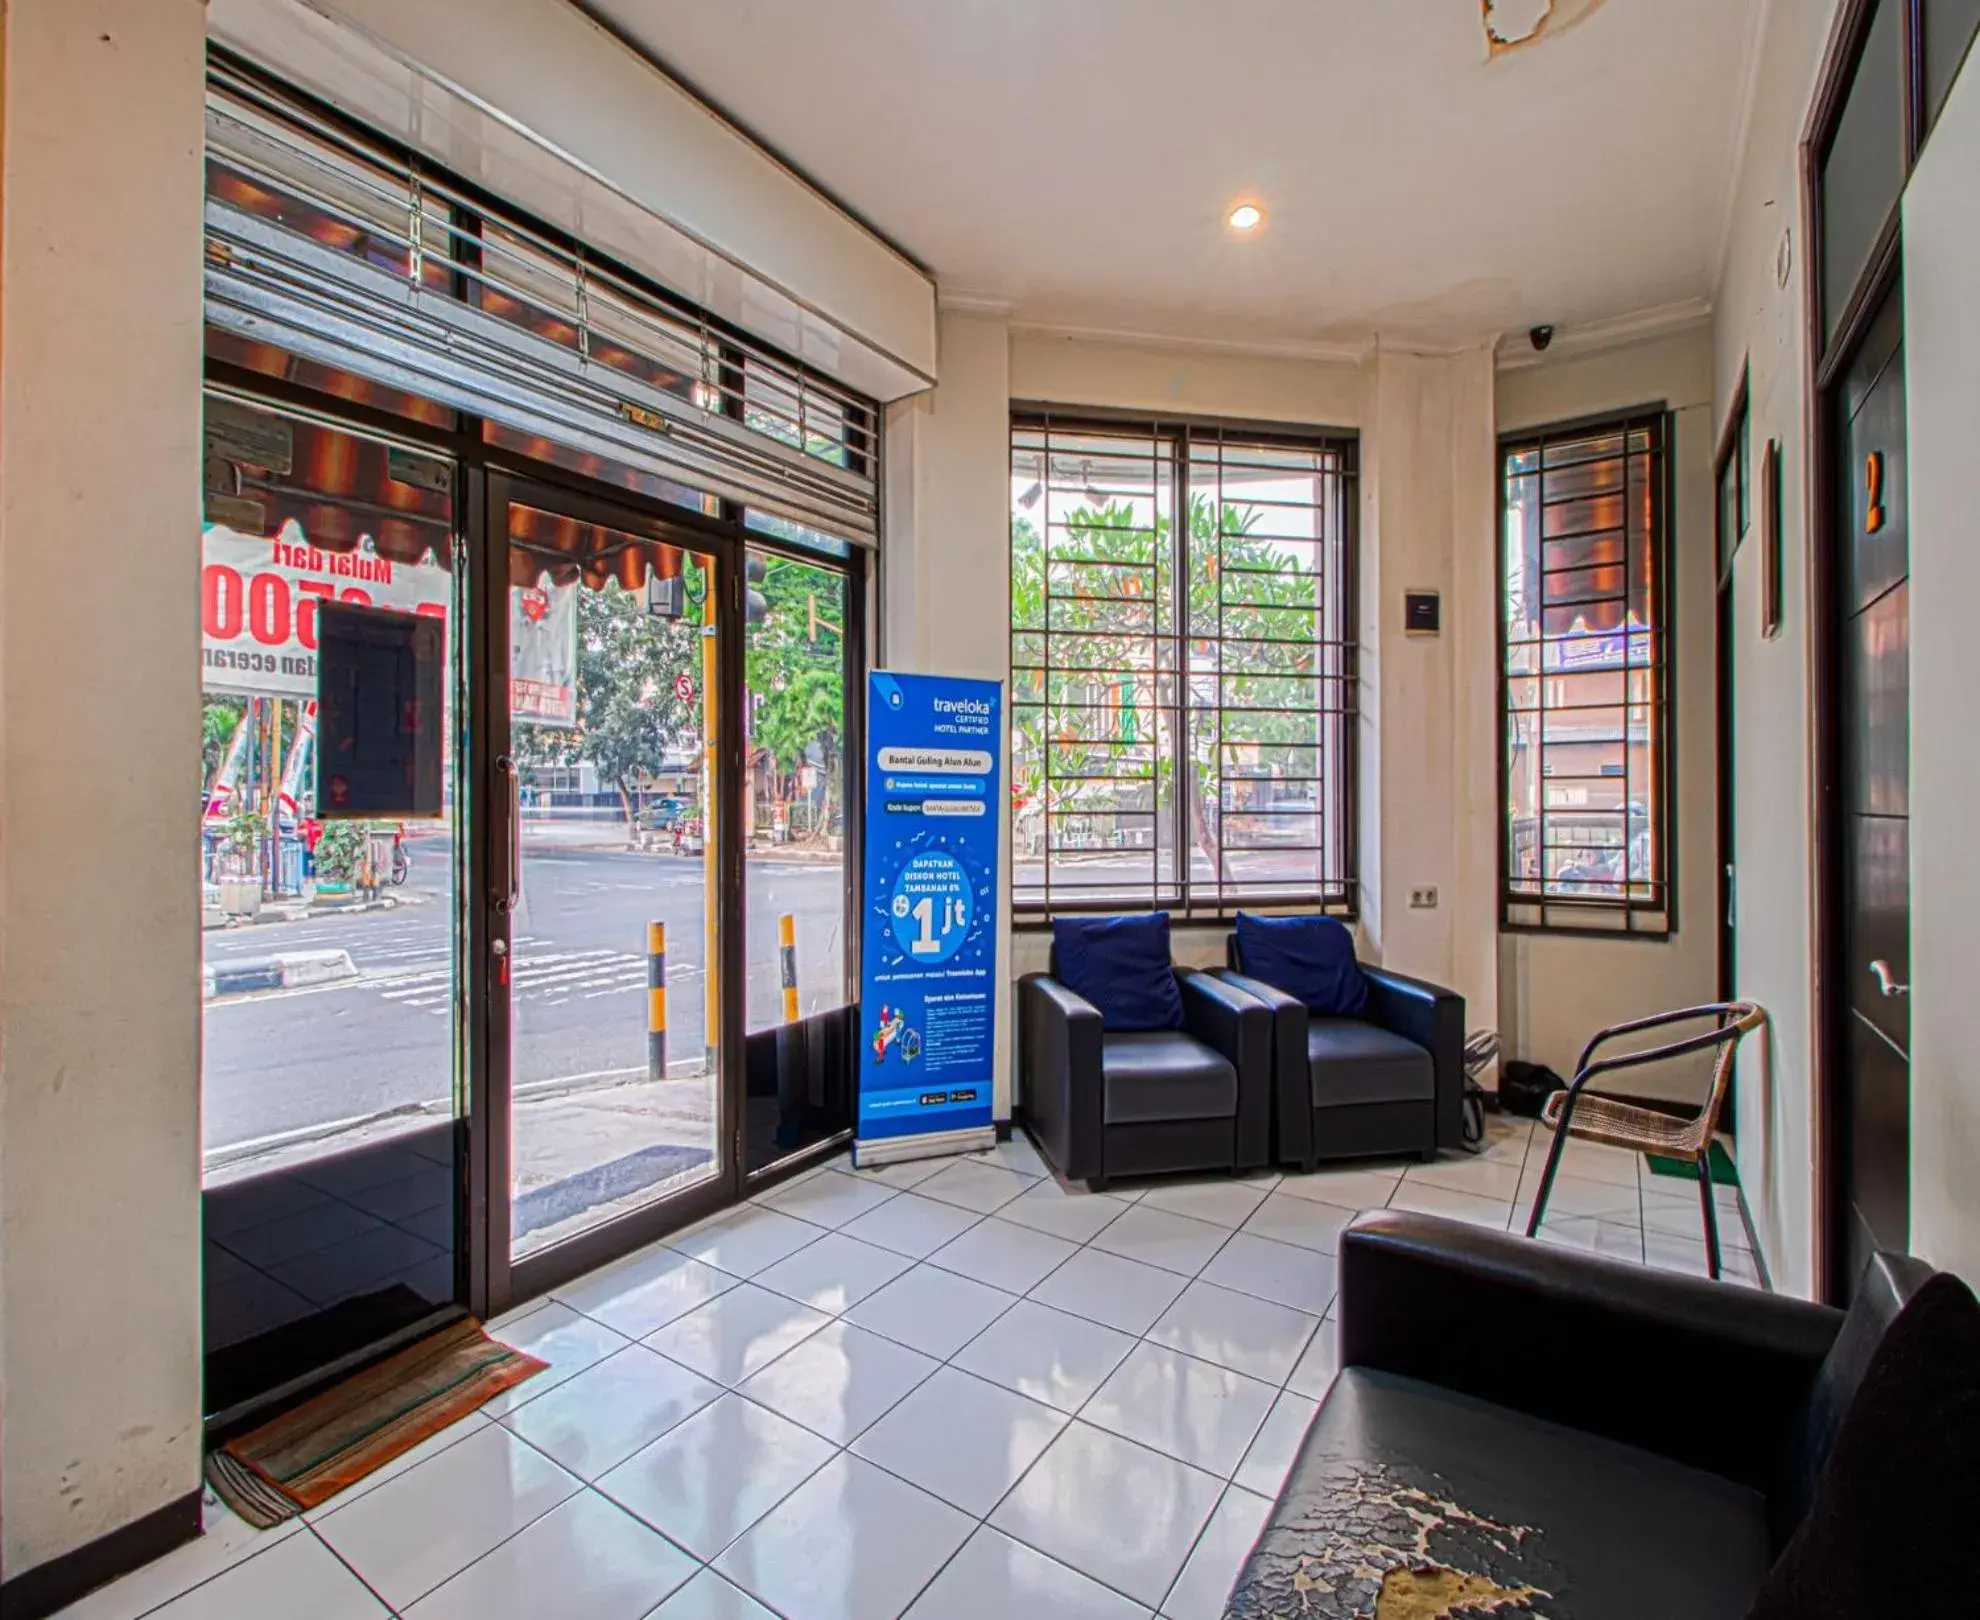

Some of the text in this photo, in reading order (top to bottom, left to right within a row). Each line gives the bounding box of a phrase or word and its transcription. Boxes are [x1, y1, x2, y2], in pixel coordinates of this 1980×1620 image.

[1865, 451, 1885, 534] 2
[934, 697, 990, 714] traveloka
[955, 714, 989, 725] CERTIFIED
[934, 723, 989, 735] HOTEL PARTNER
[912, 860, 954, 868] DAPATKAN
[904, 872, 961, 880] DISKON HOTEL
[905, 884, 947, 892] TAMBAHAN
